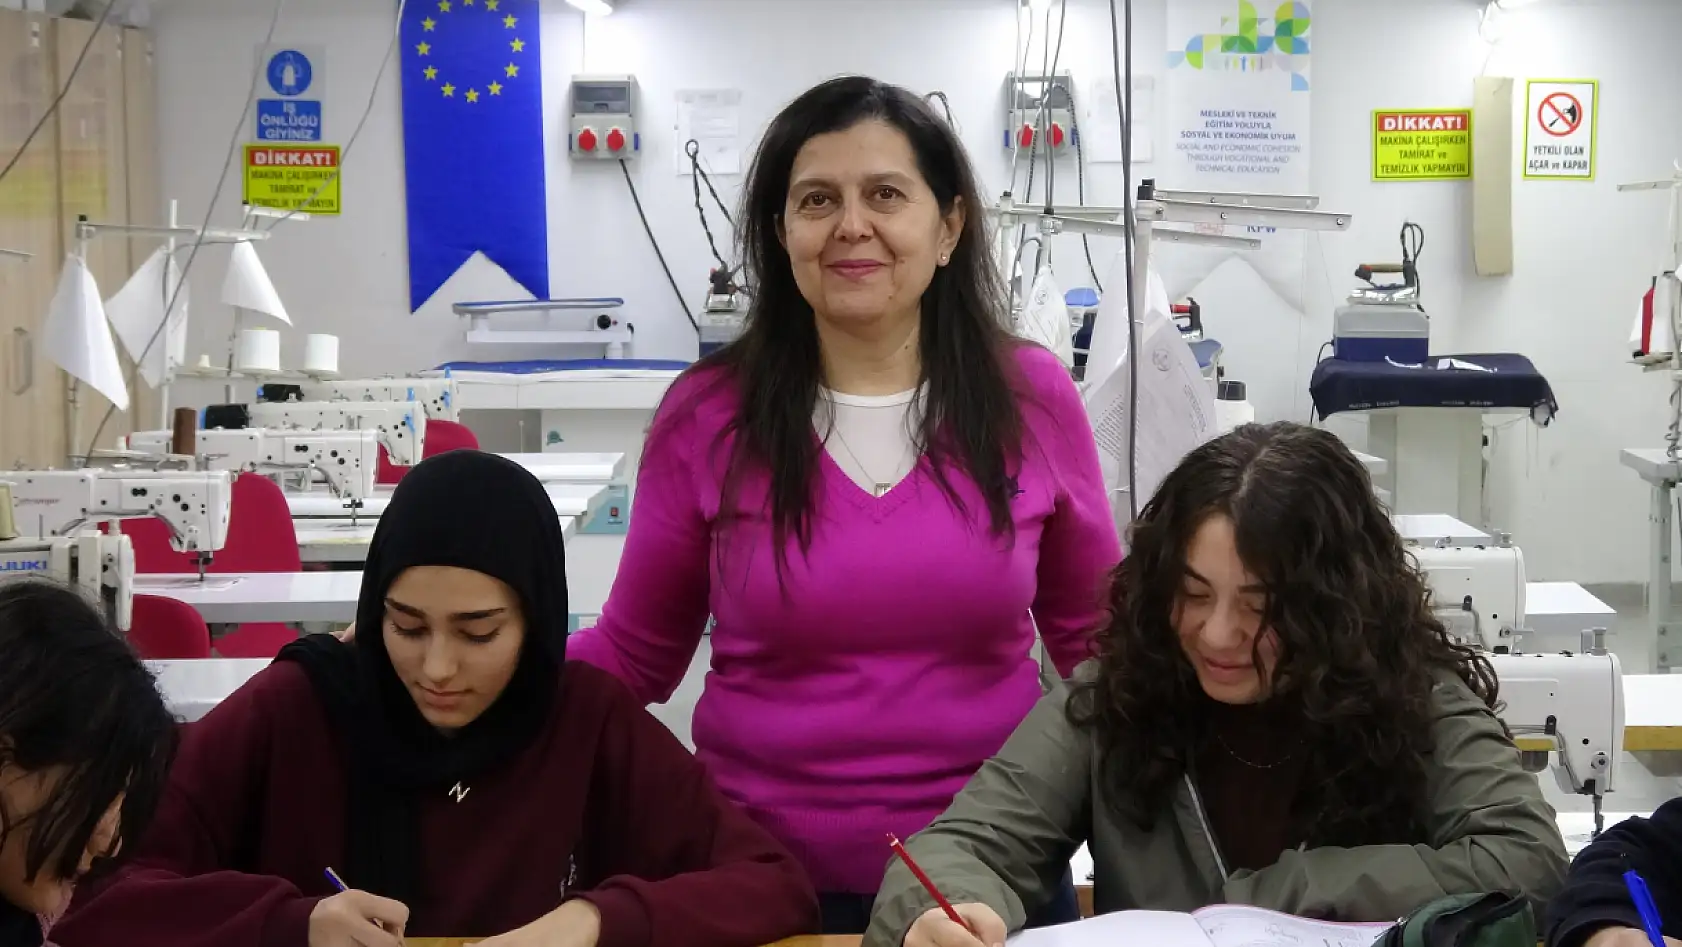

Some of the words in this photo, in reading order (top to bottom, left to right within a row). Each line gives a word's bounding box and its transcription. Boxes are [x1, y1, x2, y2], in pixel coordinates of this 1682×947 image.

[1205, 120, 1233, 129] EĞİTİM
[1235, 122, 1272, 130] YOLUYLA
[1384, 115, 1462, 131] DİKKAT!
[1180, 130, 1211, 139] SOSYAL
[1220, 144, 1261, 152] ECONOMIC
[1398, 147, 1435, 159] TAMİRAT
[1564, 145, 1585, 156] OLAN
[254, 149, 331, 165] DİKKAT!
[1273, 155, 1290, 164] AND
[1421, 163, 1466, 173] YAPMAYIN
[1529, 159, 1549, 171] AÇAR
[1551, 162, 1560, 170] ve
[1563, 159, 1588, 170] KAPAR
[0, 560, 47, 571] JUKI
